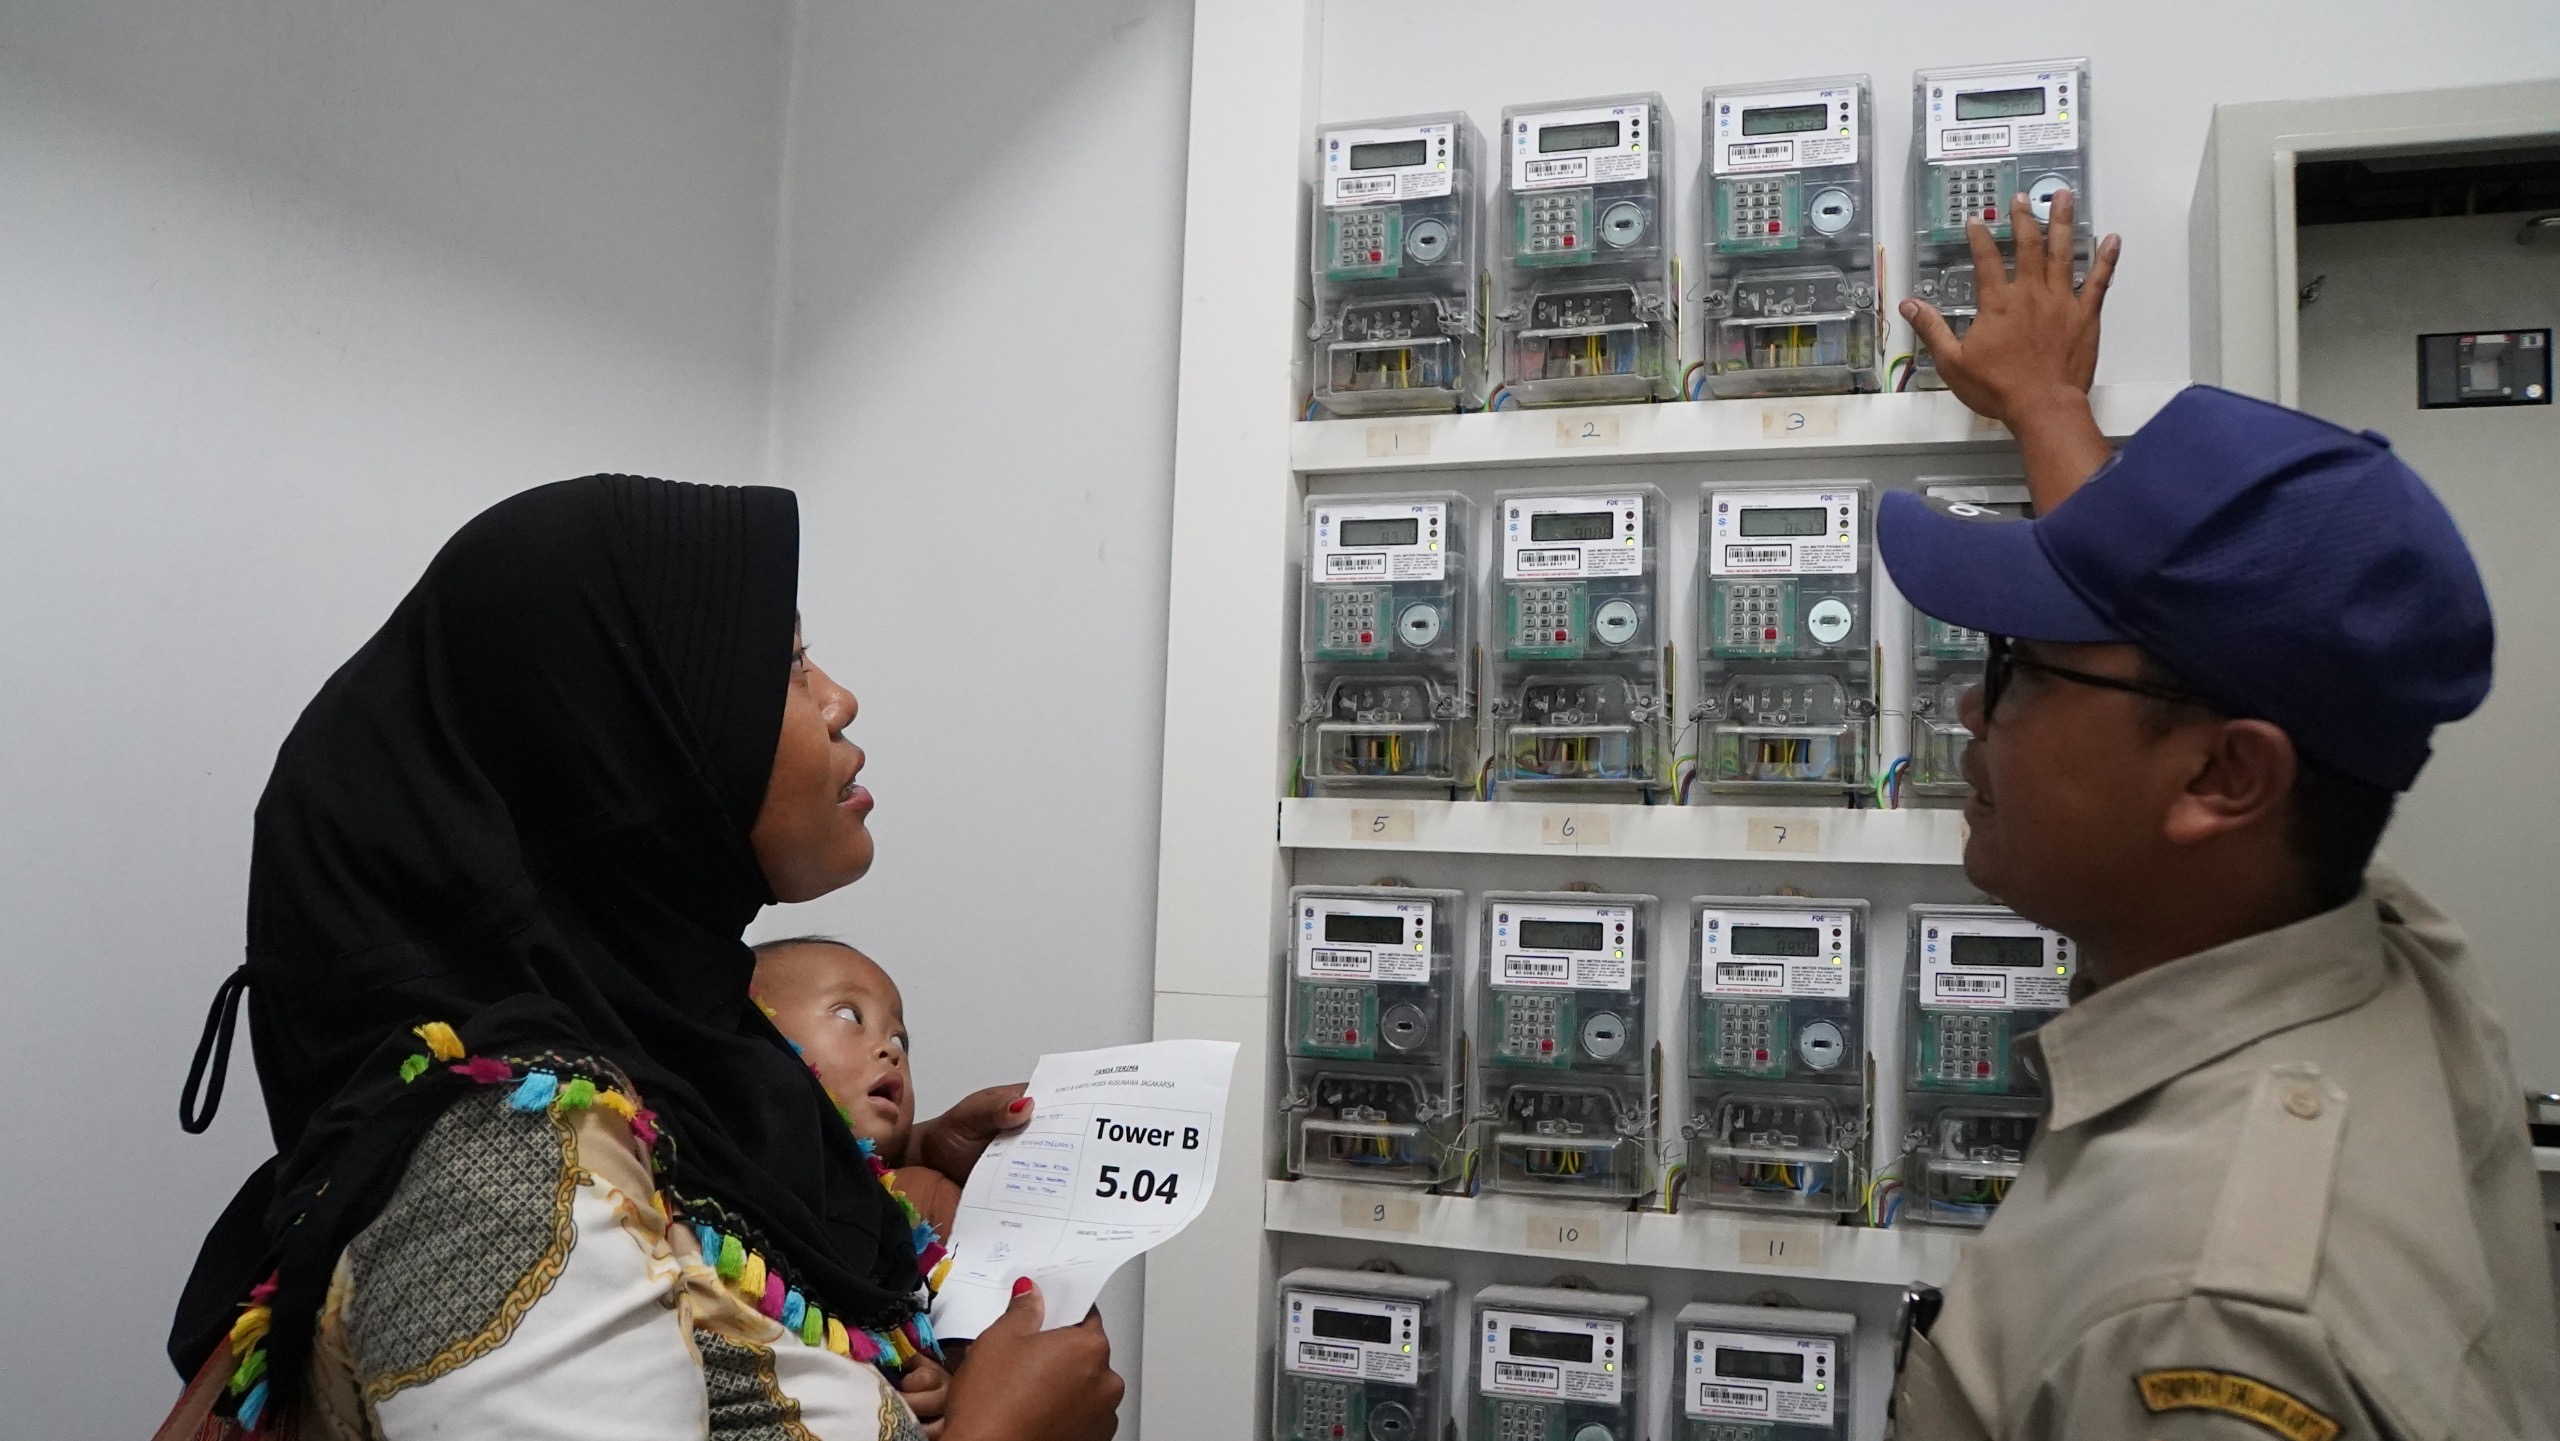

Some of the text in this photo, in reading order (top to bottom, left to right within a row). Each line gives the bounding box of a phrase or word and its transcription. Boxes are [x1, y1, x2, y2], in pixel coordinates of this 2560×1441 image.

[1581, 422, 1600, 438] 2
[1786, 412, 1804, 430] 3
[1373, 814, 1390, 833] 5
[1562, 817, 1575, 837] 6
[1774, 826, 1787, 844] 7
[1115, 1065, 1138, 1073] TERIMA
[1140, 1080, 1175, 1088] JAGAKARSA
[1096, 1118, 1199, 1150] Tower B
[1096, 1165, 1178, 1204] 5.04
[1373, 1204, 1385, 1222] 9
[1558, 1226, 1579, 1243] 10
[1770, 1240, 1784, 1257] 11
